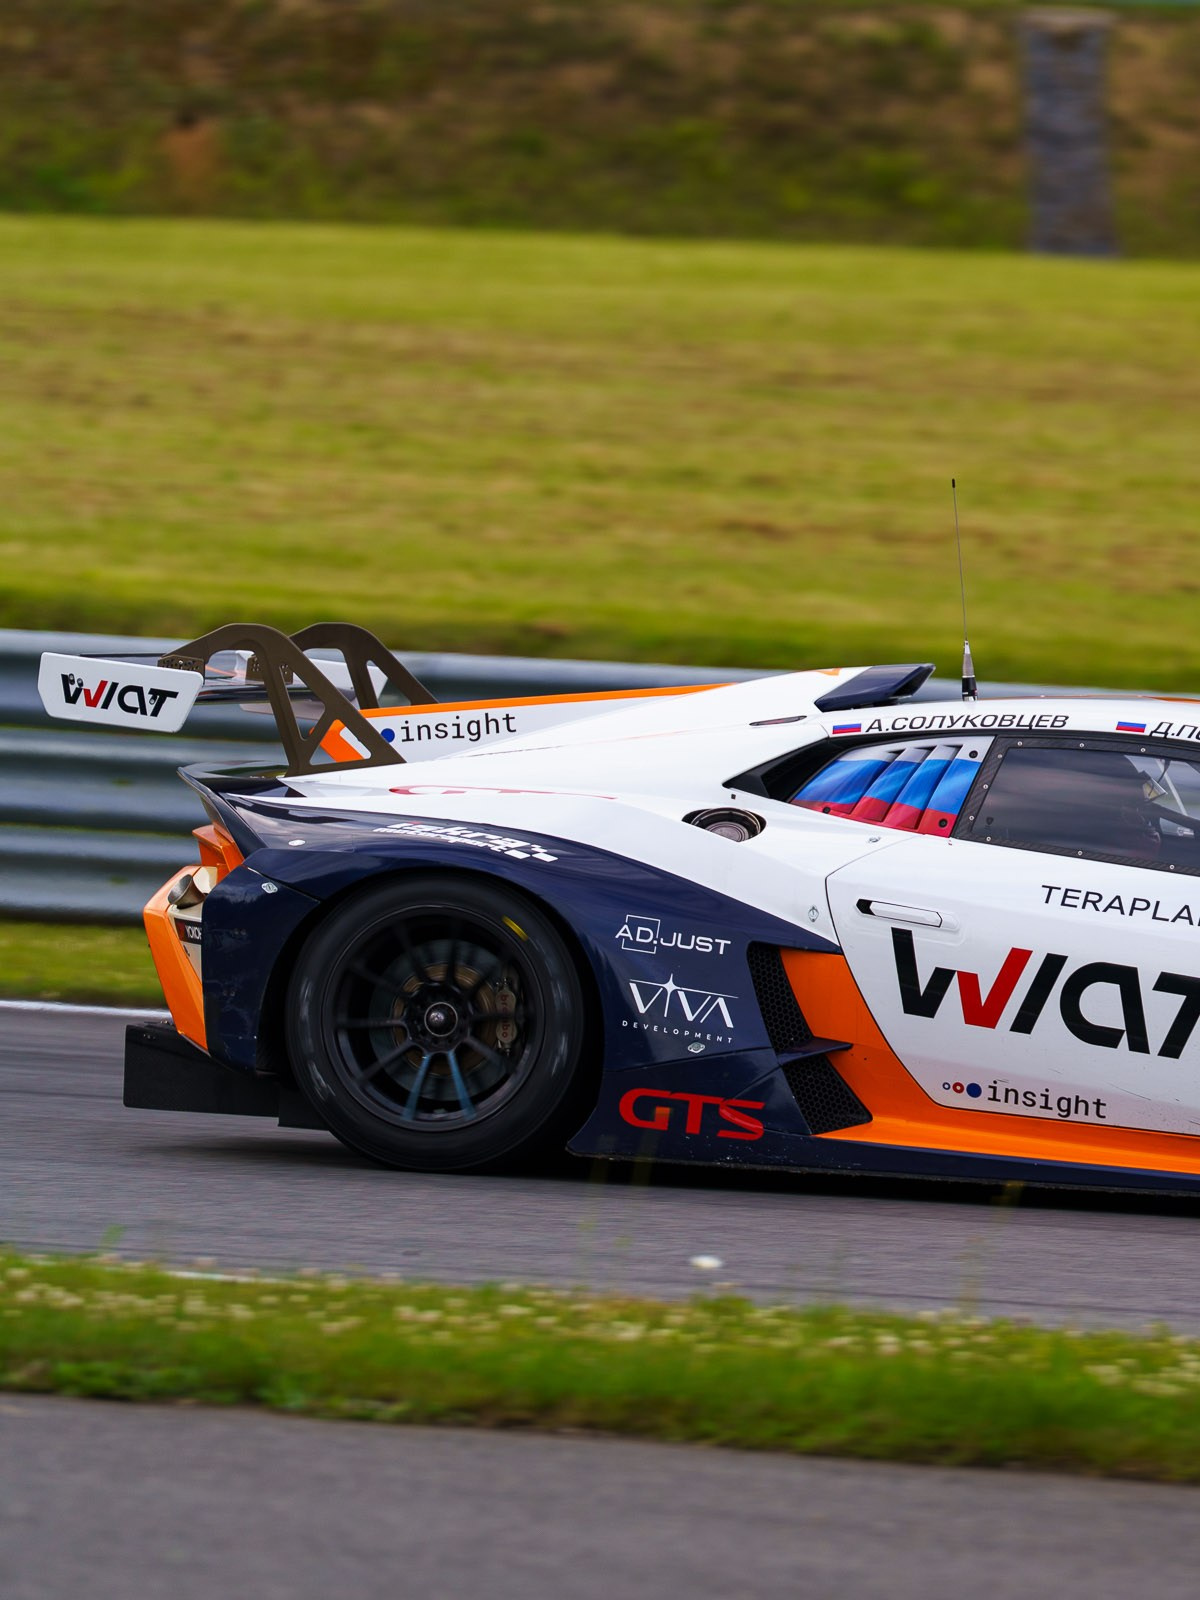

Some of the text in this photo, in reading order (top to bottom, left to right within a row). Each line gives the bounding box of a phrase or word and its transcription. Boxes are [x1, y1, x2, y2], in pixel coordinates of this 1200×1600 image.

[61, 673, 179, 718] WIAT
[400, 712, 518, 743] insight
[865, 714, 1069, 733] А.СОЛУКОВЦЕВ
[622, 1020, 733, 1043] DEVELOPMENT
[618, 1088, 765, 1141] GTS
[987, 1079, 1107, 1119] insight
